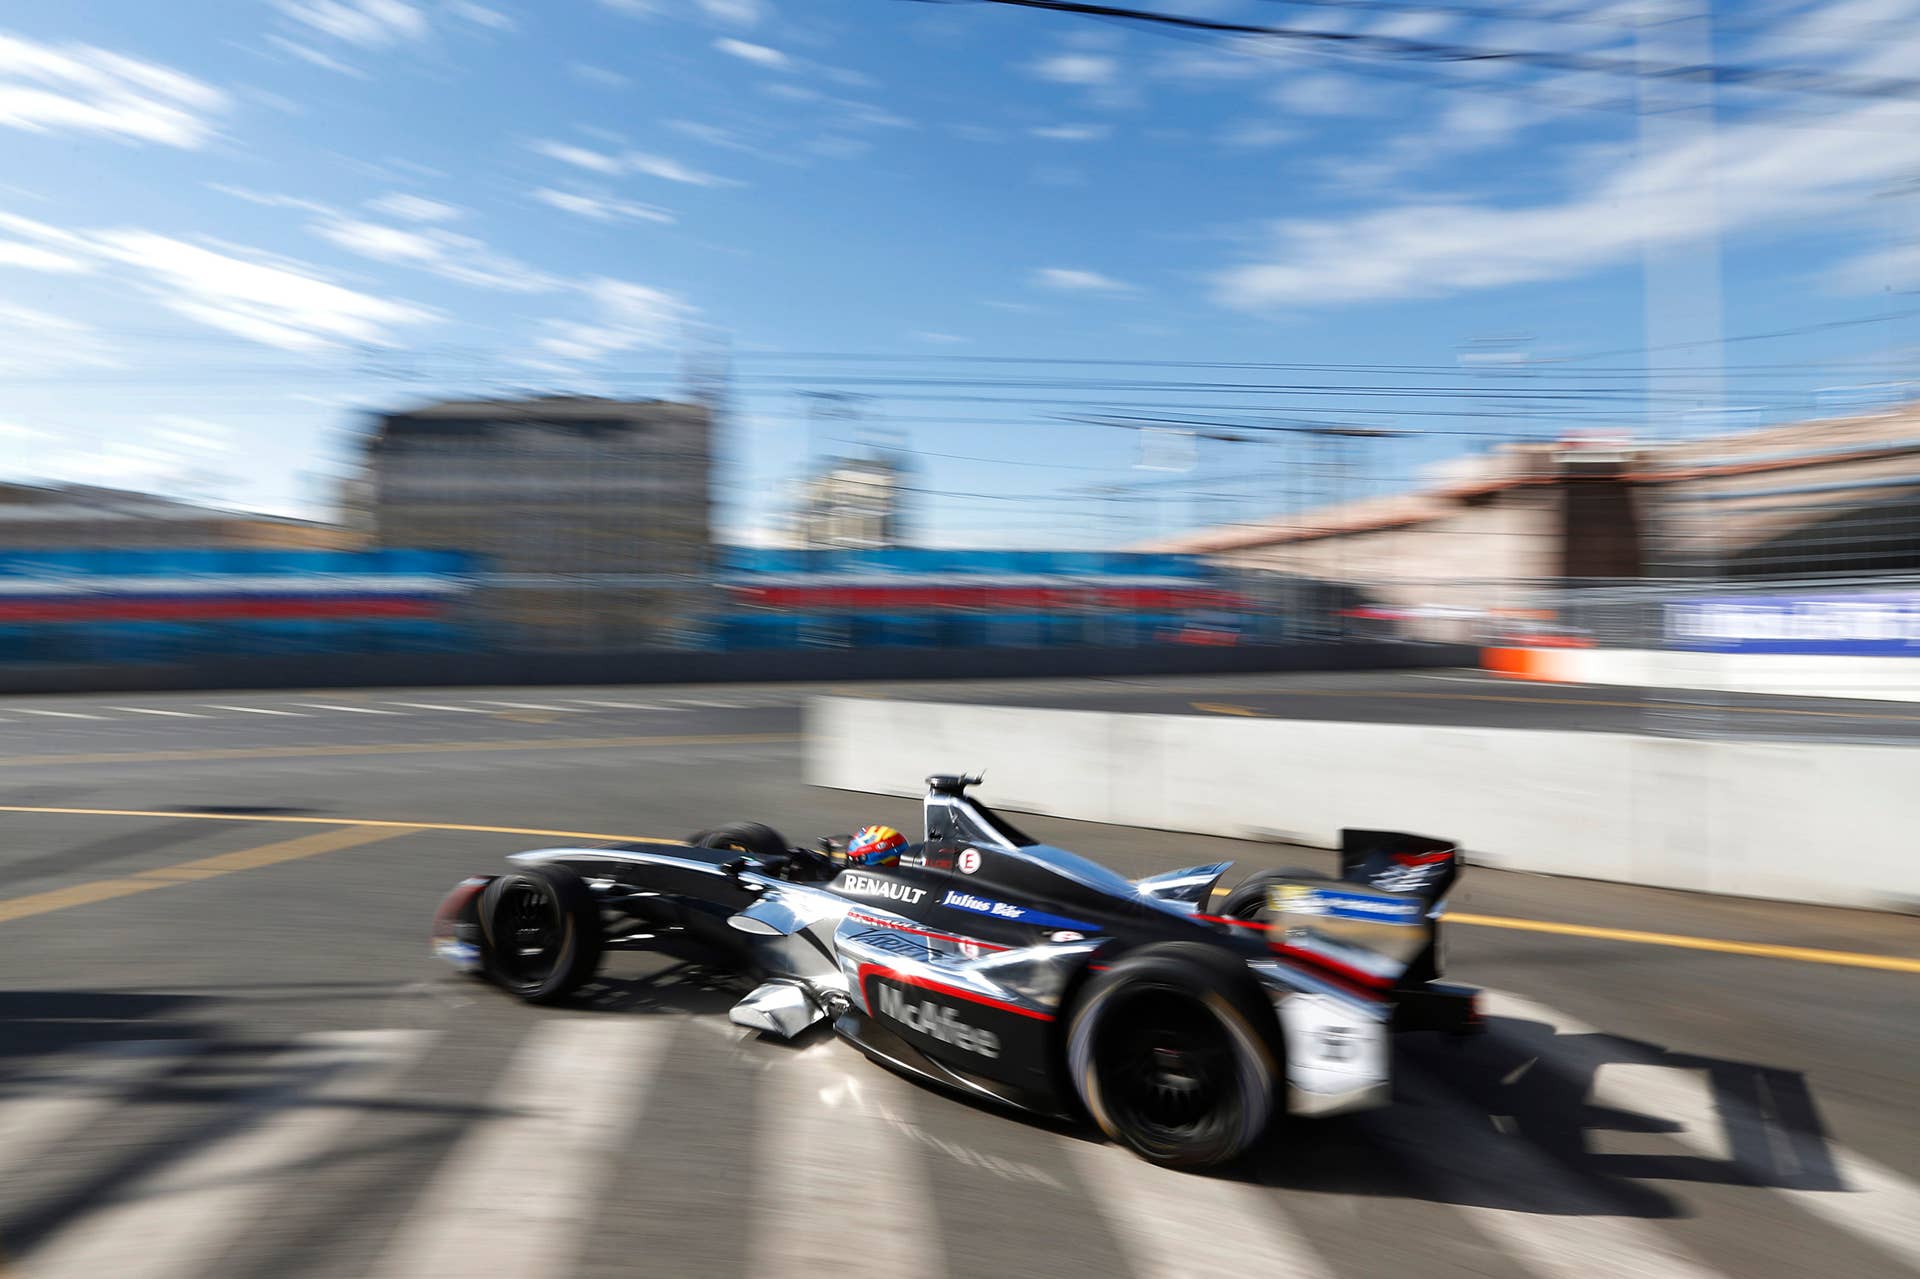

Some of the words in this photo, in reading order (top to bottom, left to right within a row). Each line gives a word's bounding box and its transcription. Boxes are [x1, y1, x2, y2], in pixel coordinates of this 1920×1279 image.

[964, 853, 974, 869] E
[844, 874, 927, 904] RENAULT
[943, 890, 990, 912] Julius
